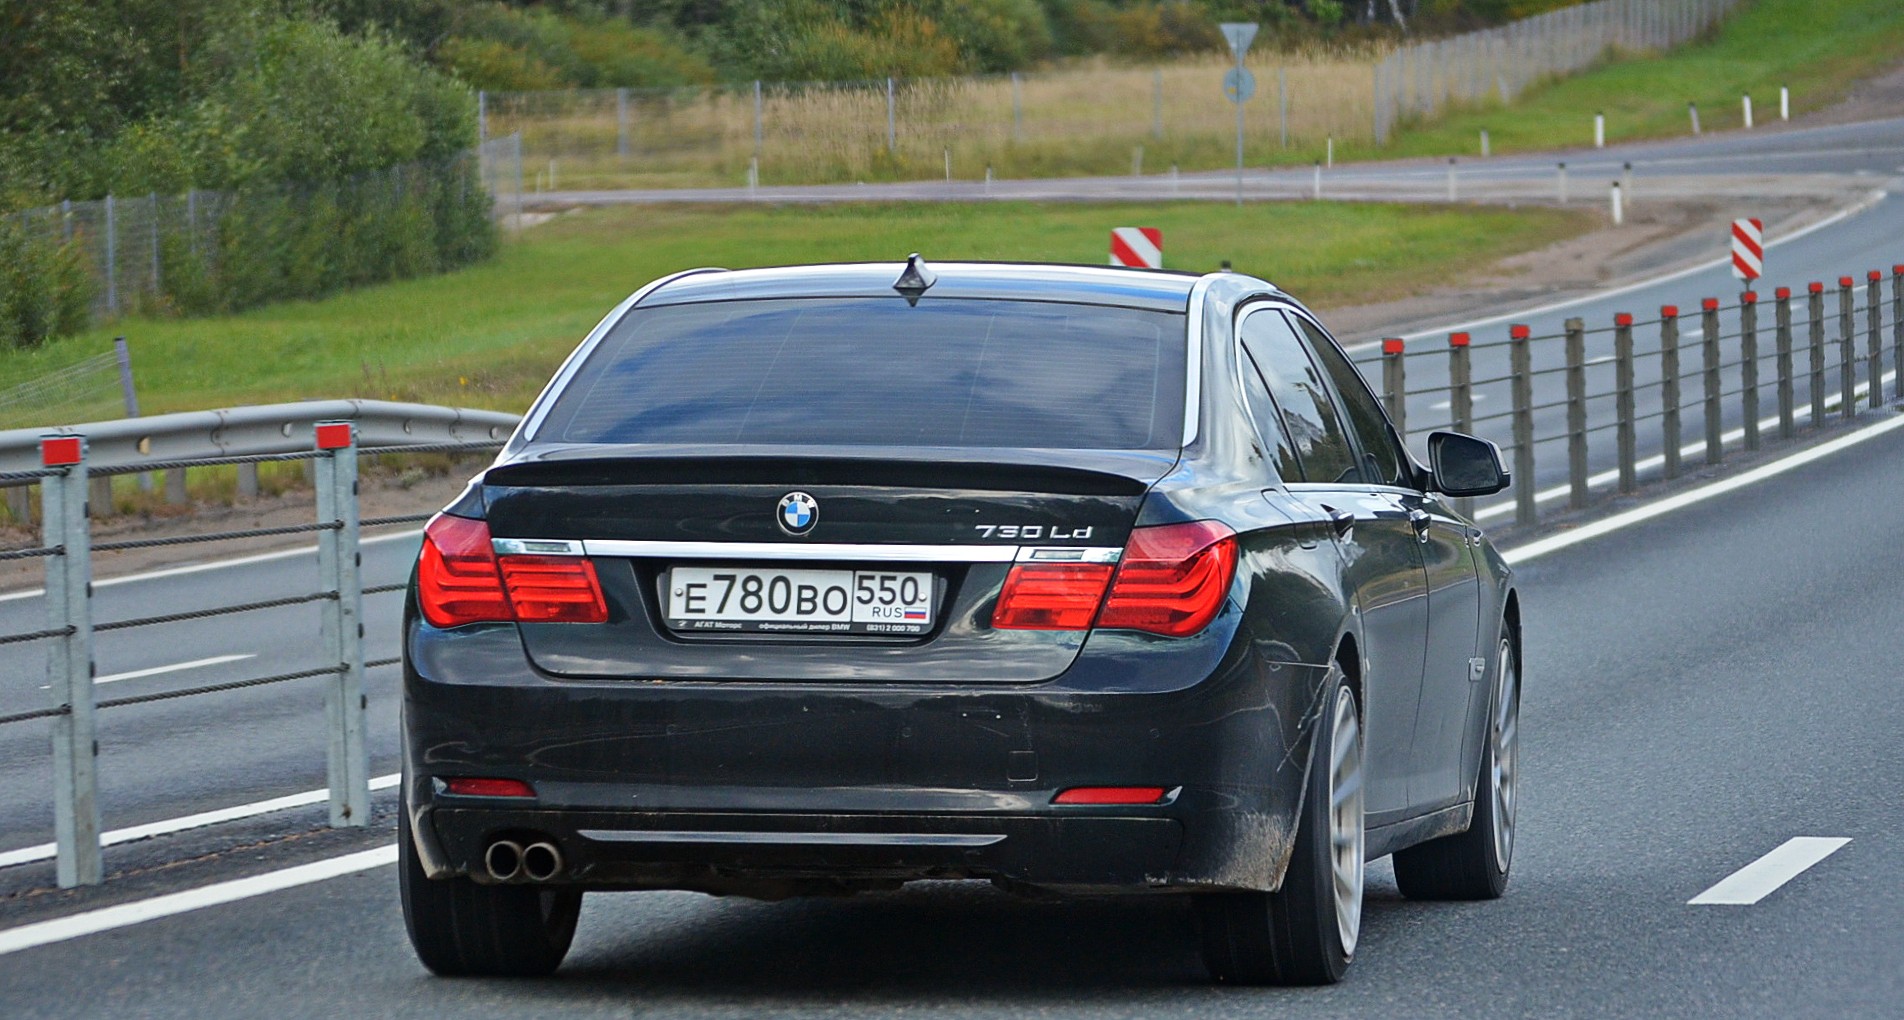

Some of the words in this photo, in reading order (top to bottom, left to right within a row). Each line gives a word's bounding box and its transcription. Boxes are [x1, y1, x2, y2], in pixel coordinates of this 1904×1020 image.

[781, 494, 815, 508] BMW
[975, 525, 1043, 538] 730
[1049, 526, 1093, 539] Ld
[856, 575, 919, 606] 550
[872, 607, 903, 618] RUS
